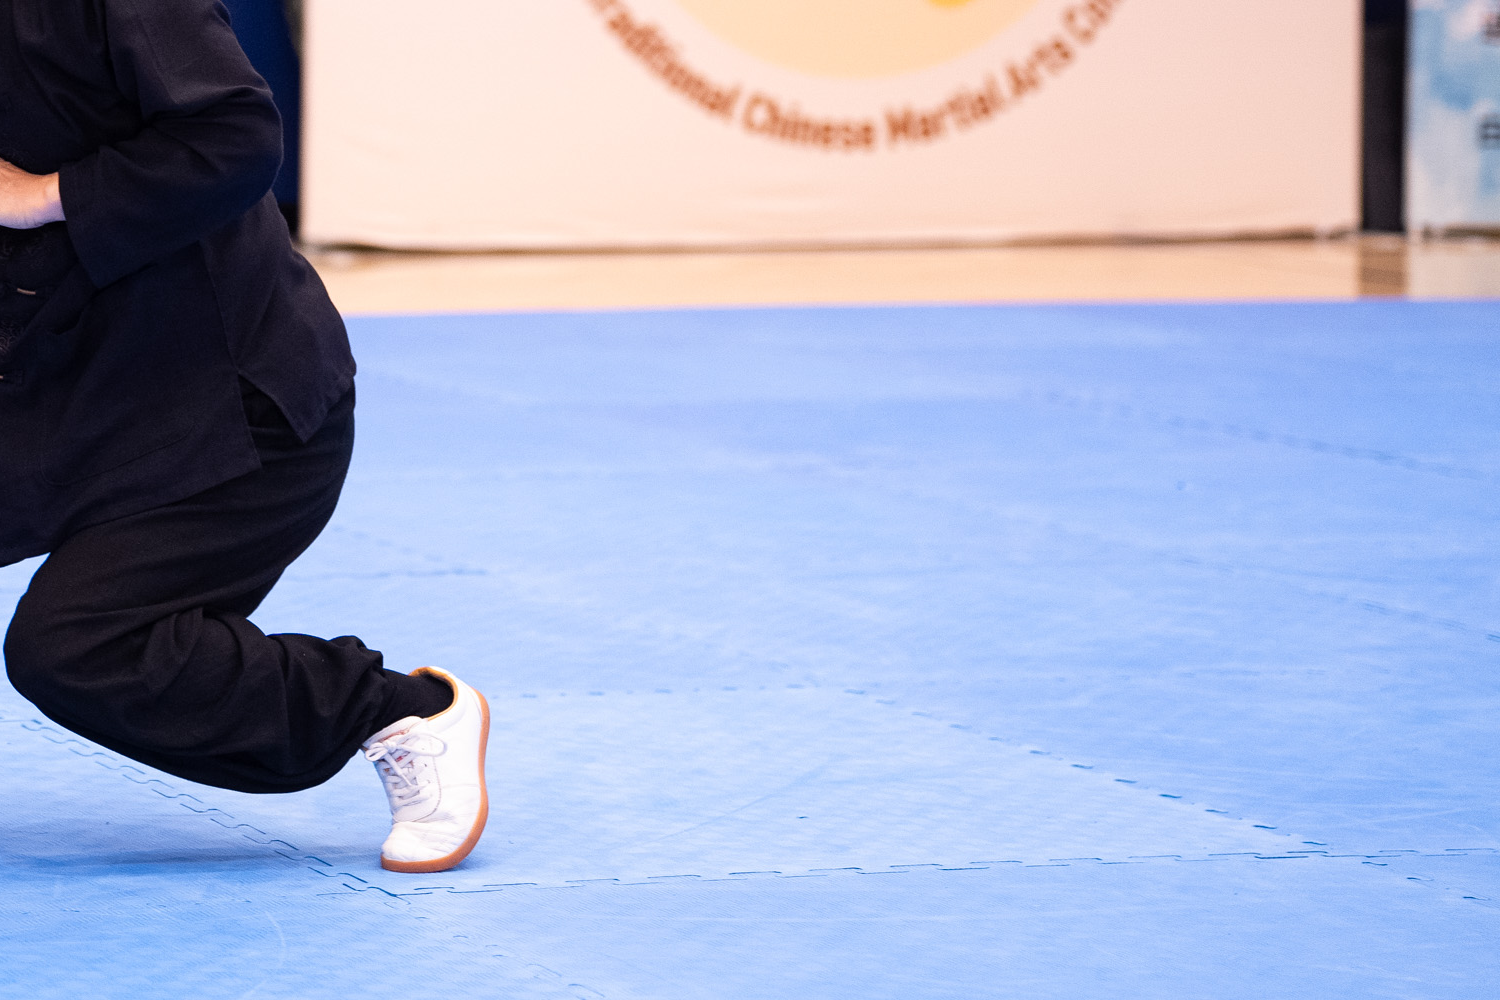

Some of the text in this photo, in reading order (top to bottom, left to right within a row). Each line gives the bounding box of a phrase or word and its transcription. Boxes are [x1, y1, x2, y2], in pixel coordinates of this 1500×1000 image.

[743, 93, 875, 149] Chinese
[884, 73, 1002, 146] Martial
[1006, 36, 1074, 98] Arts
